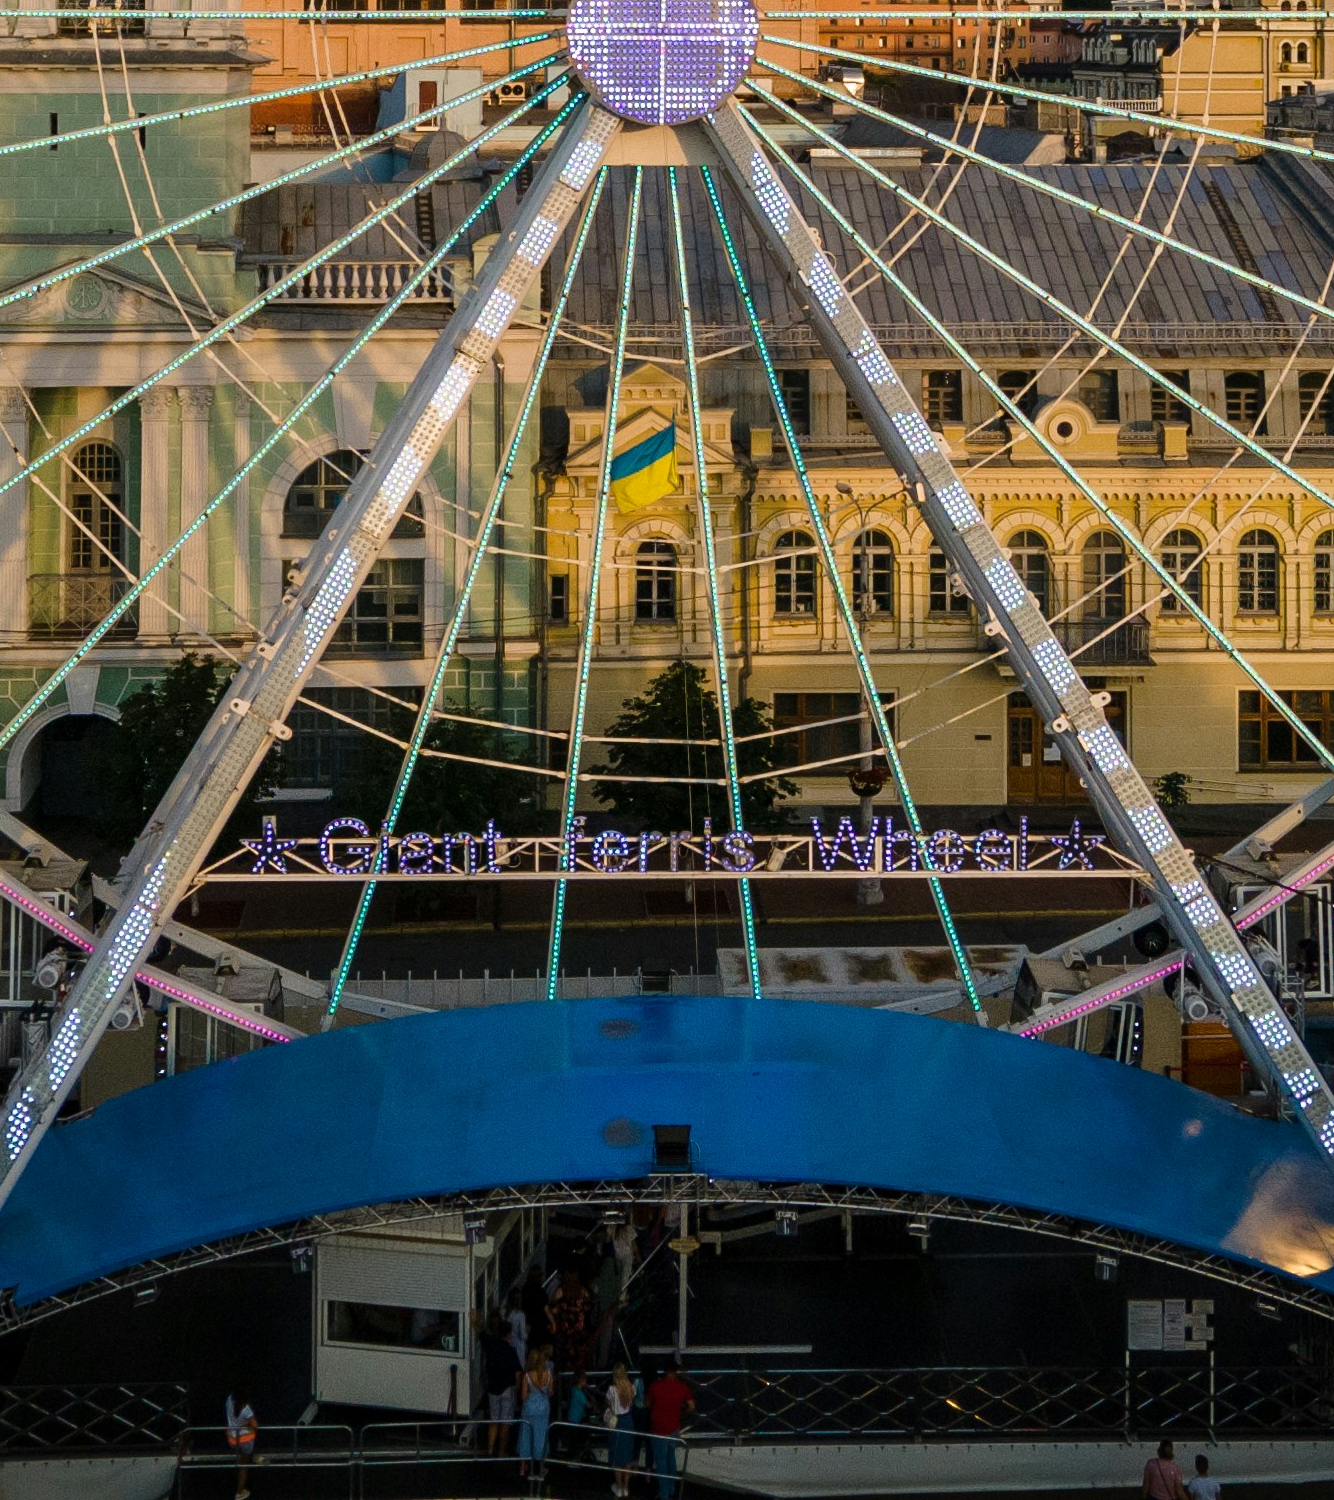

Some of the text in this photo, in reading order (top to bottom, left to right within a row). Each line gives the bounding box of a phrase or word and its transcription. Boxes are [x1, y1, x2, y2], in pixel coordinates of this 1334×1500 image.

[320, 816, 1028, 876] Giant ferris Wheel
